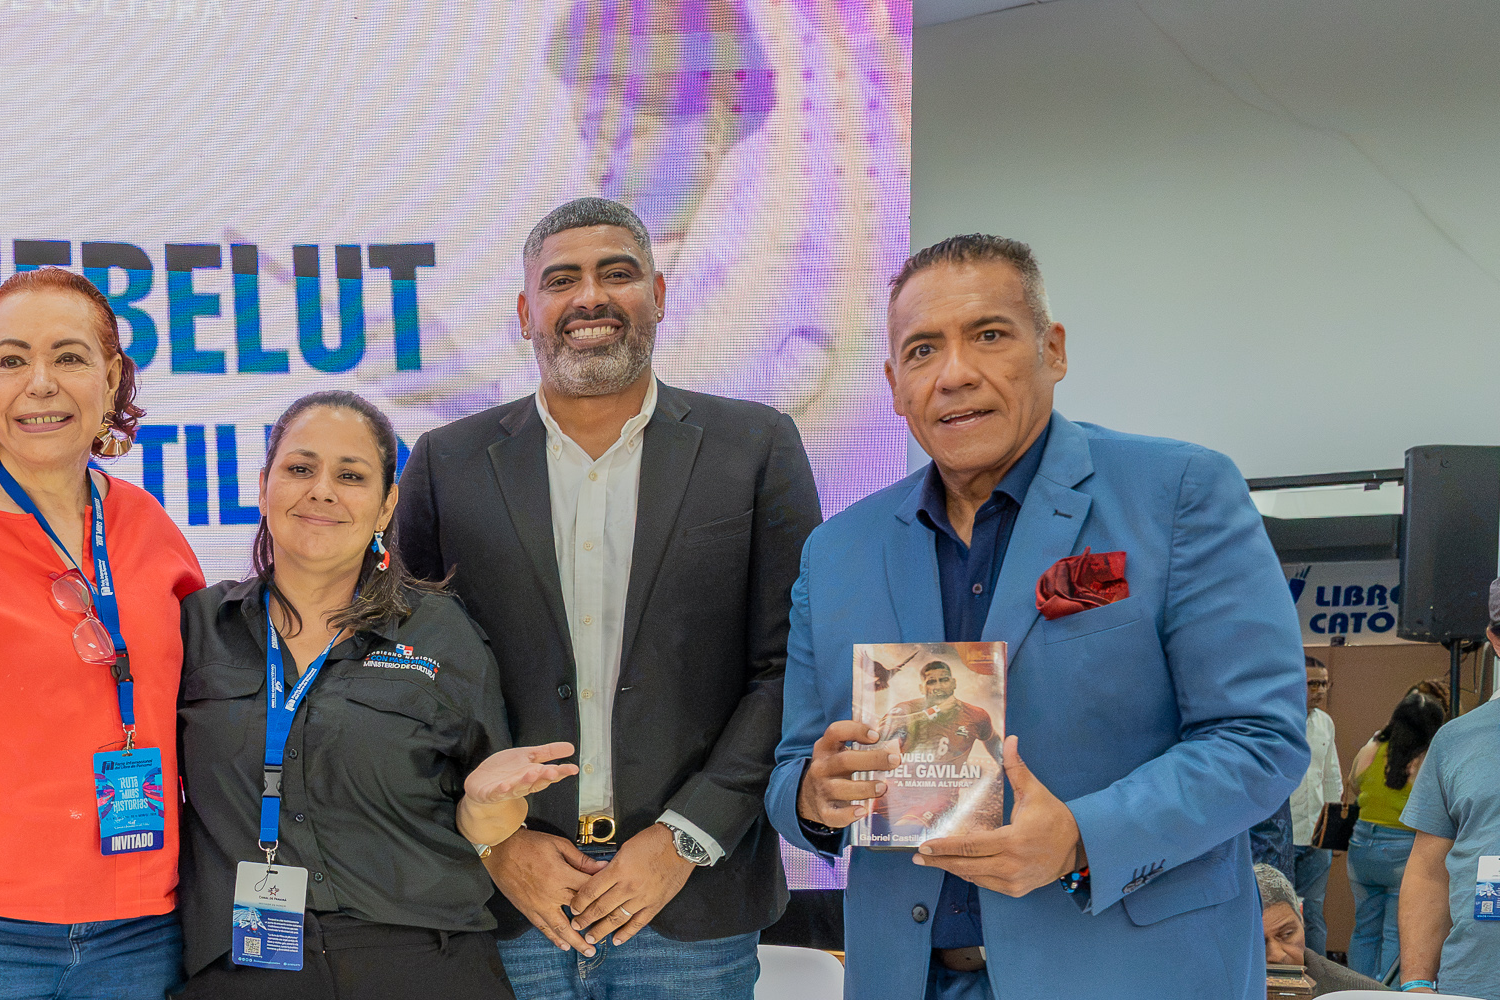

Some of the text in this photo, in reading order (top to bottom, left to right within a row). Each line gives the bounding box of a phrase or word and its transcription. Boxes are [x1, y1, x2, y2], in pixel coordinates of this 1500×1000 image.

[363, 660, 400, 669] MINISTERIO
[410, 664, 436, 680] CULTURA
[410, 660, 434, 671] FIRME
[900, 753, 935, 764] VUELO
[916, 762, 980, 778] GAVILÁN
[112, 832, 154, 852] INVITADO
[860, 834, 890, 842] Gabriel
